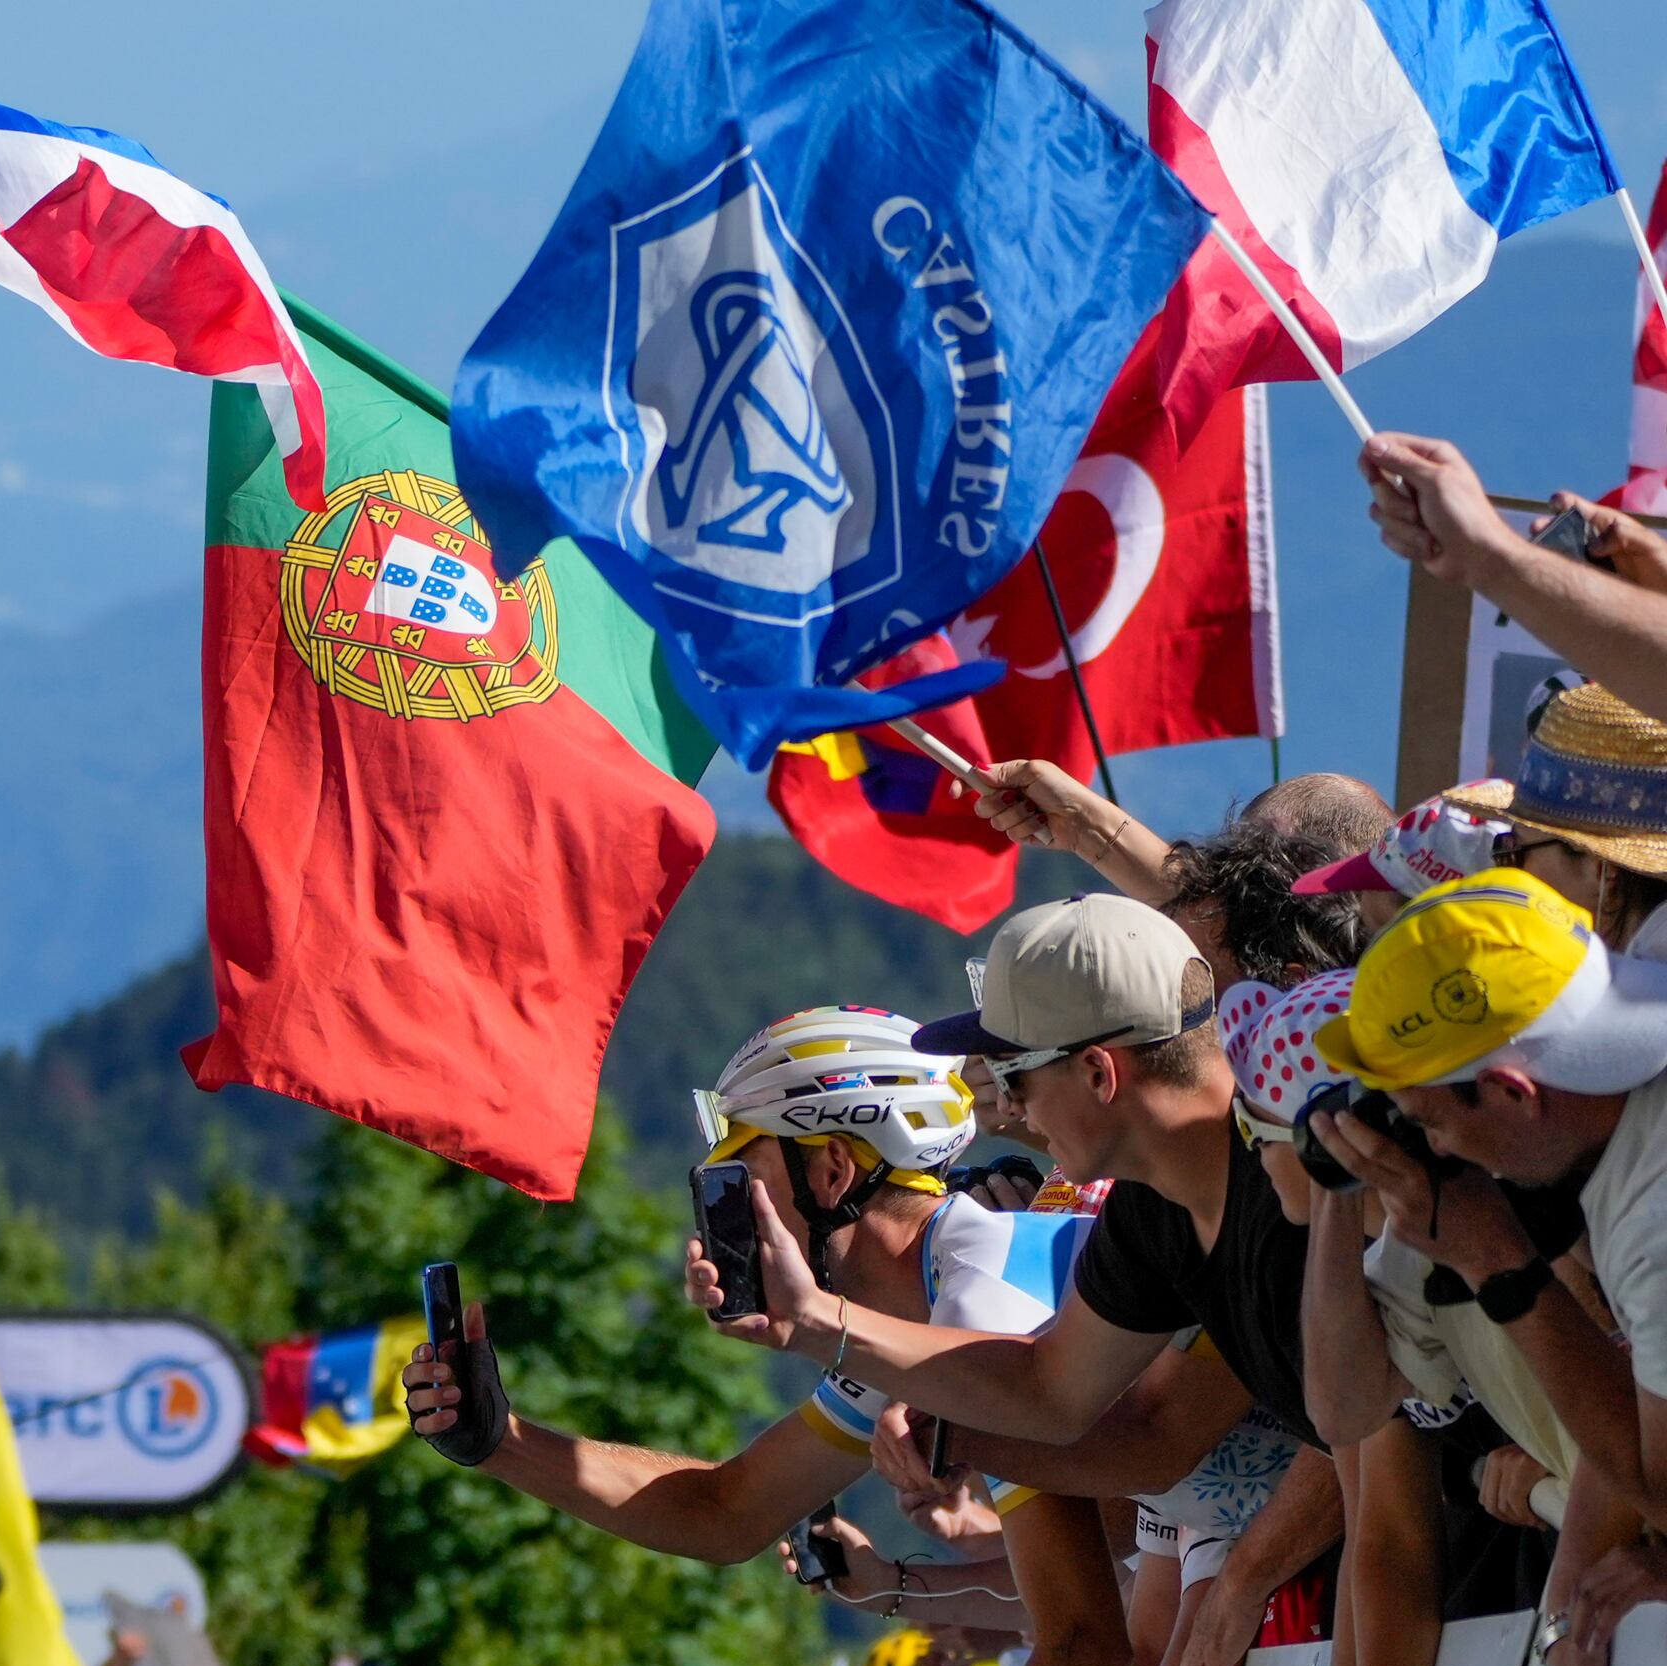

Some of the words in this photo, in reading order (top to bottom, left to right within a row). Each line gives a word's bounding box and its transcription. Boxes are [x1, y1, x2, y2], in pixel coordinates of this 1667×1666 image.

[1406, 848, 1464, 883] Cham
[1390, 1012, 1434, 1039] LCL
[1038, 1188, 1071, 1201] chonou
